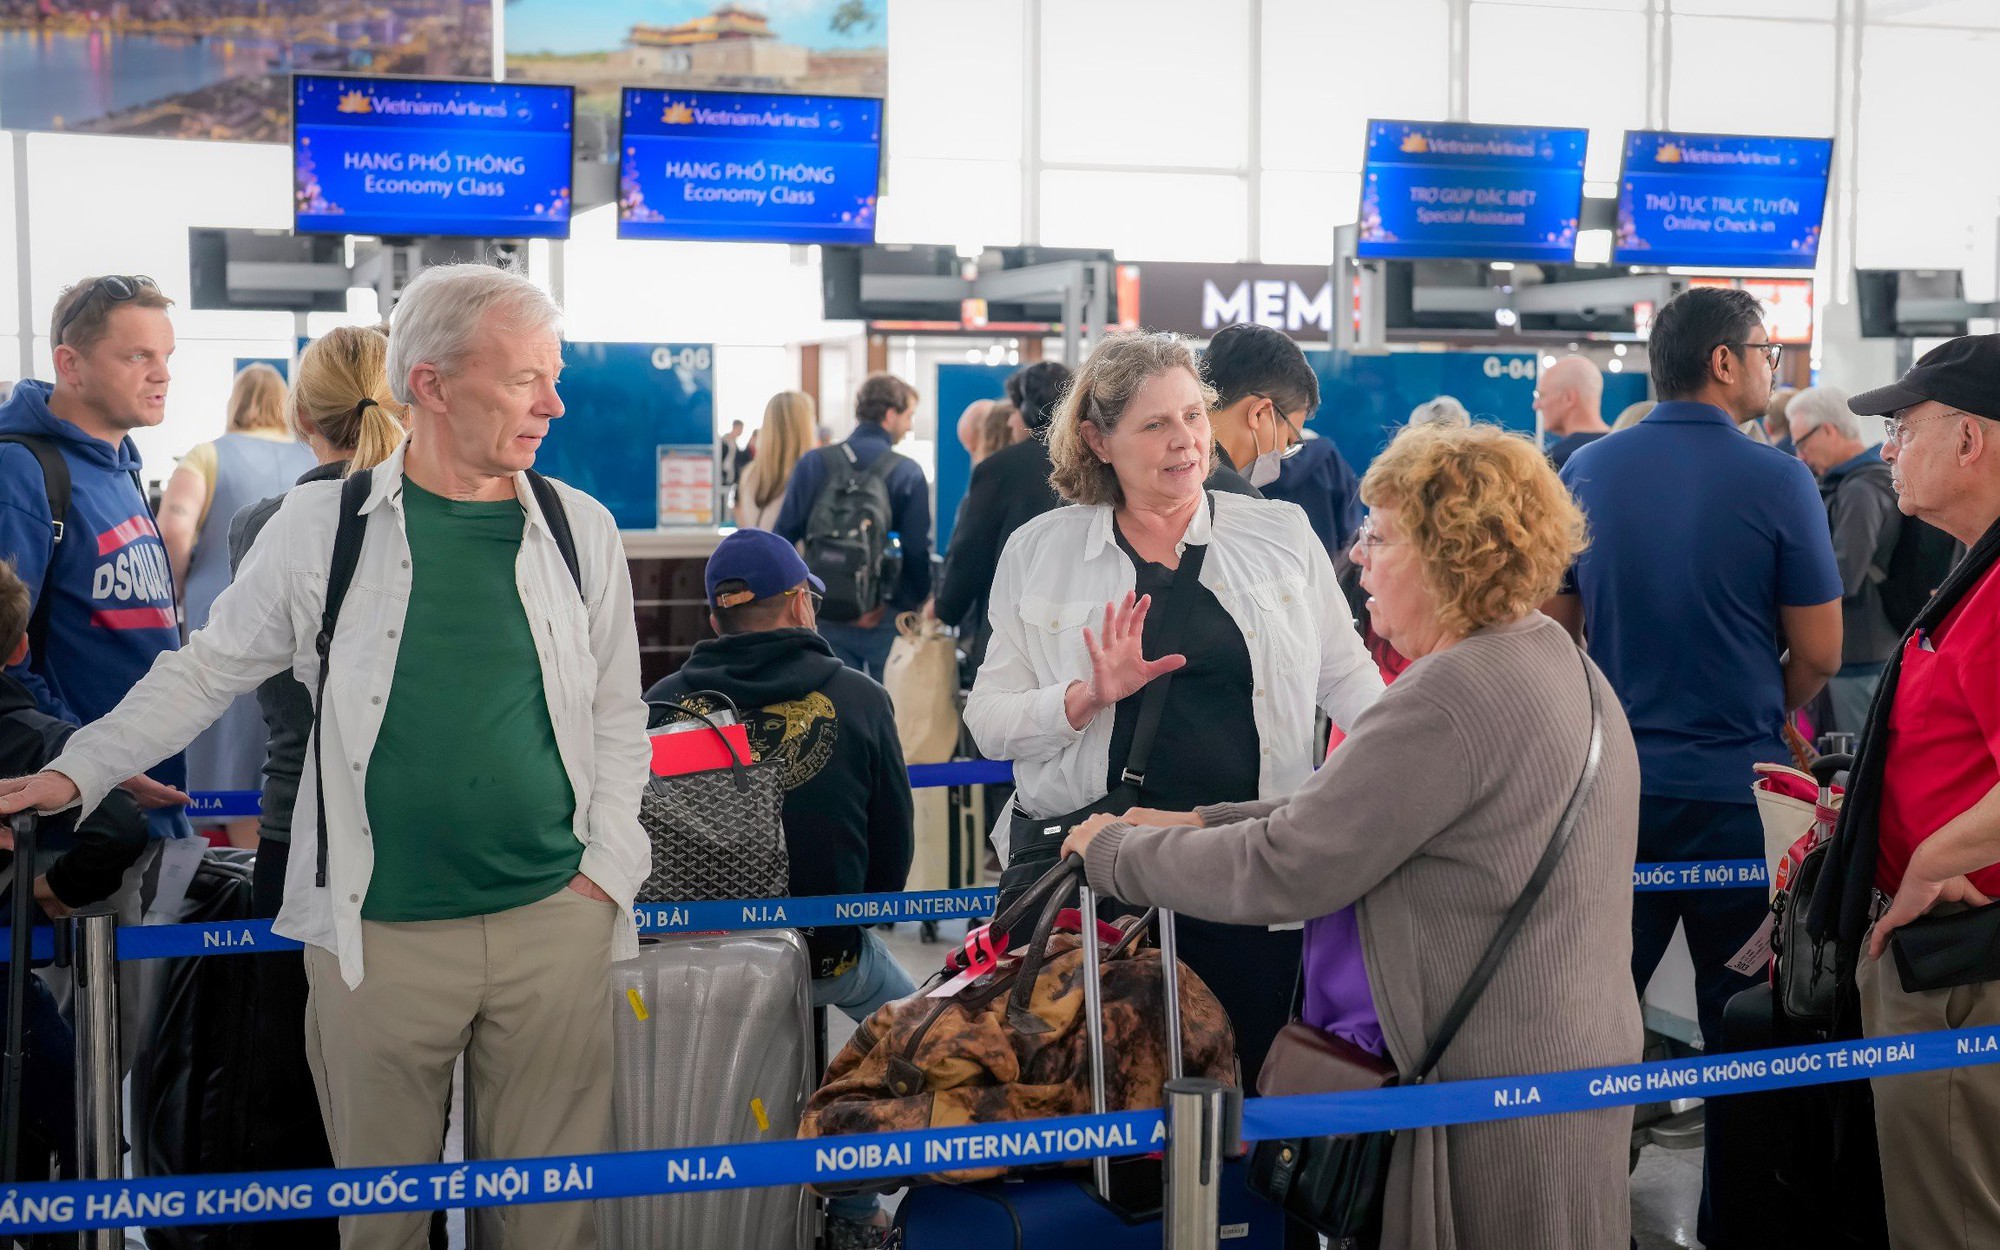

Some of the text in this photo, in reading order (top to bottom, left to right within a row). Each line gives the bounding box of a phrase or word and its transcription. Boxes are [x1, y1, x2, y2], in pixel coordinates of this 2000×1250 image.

[365, 174, 505, 199] Economy Class
[684, 183, 815, 207] Economy Class
[1663, 214, 1712, 232] Online
[651, 347, 711, 370] G-06
[1483, 356, 1536, 380] G-04
[1680, 864, 1702, 884] TẾ
[1704, 865, 1733, 887] NỘI
[1738, 864, 1765, 882] BÀI
[657, 907, 689, 927] BÀI
[742, 905, 787, 923] N.I.A
[836, 900, 898, 918] NOIBAI
[203, 929, 255, 948] N.I.A
[1957, 1035, 1999, 1055] N.I.A
[1494, 1086, 1541, 1108] N.I.A
[1646, 1068, 1698, 1090] HÀNG
[1702, 1060, 1767, 1083] KHÔNG
[1852, 1046, 1881, 1069] NỘI
[1886, 1042, 1915, 1062] BÀI
[85, 1188, 186, 1221] HÀNG
[196, 1182, 313, 1216] KHÔNG
[327, 1170, 419, 1207] QUỐC
[429, 1165, 469, 1201] TẾ
[475, 1165, 530, 1202] NỘI
[543, 1162, 594, 1194] BÀI
[667, 1155, 737, 1184] N.I.A
[816, 1141, 912, 1173] NOIBAI
[924, 1122, 1138, 1164] INTERNATIONAL
